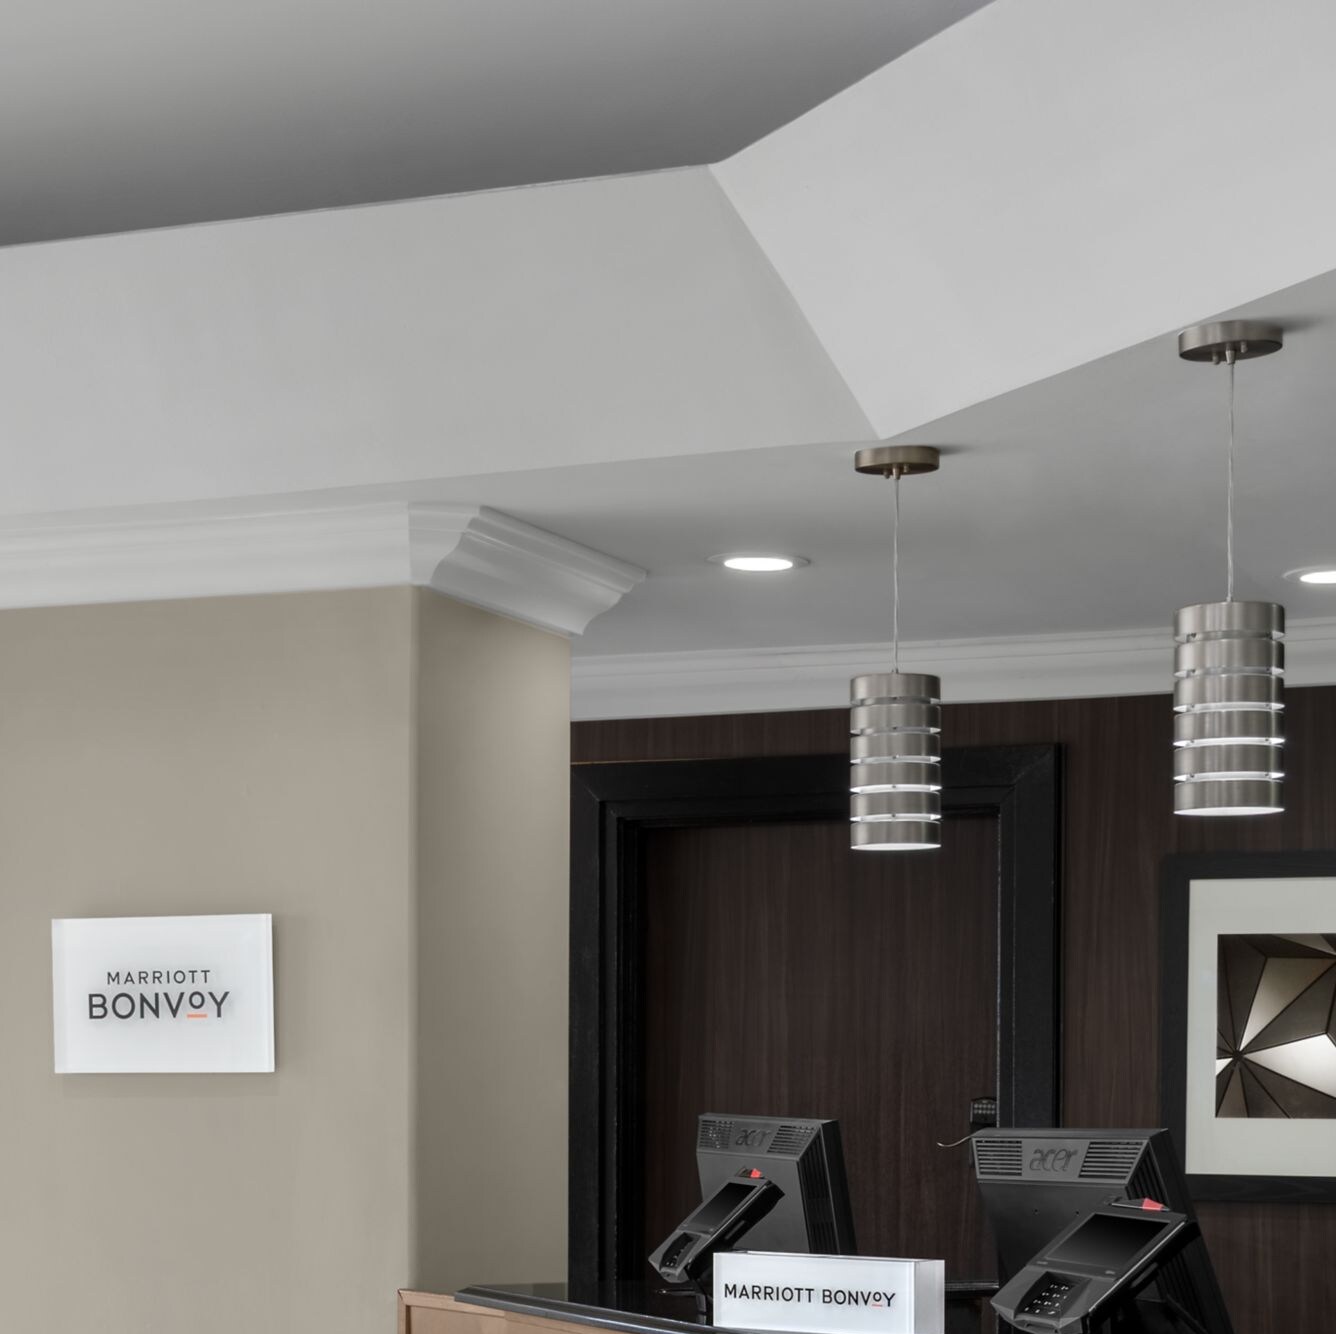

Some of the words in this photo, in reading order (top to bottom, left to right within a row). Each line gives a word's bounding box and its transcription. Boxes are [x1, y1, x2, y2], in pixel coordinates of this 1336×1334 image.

[107, 971, 210, 985] MARRIOTT
[1029, 1148, 1078, 1172] acer
[724, 1283, 815, 1303] MARRIOTT
